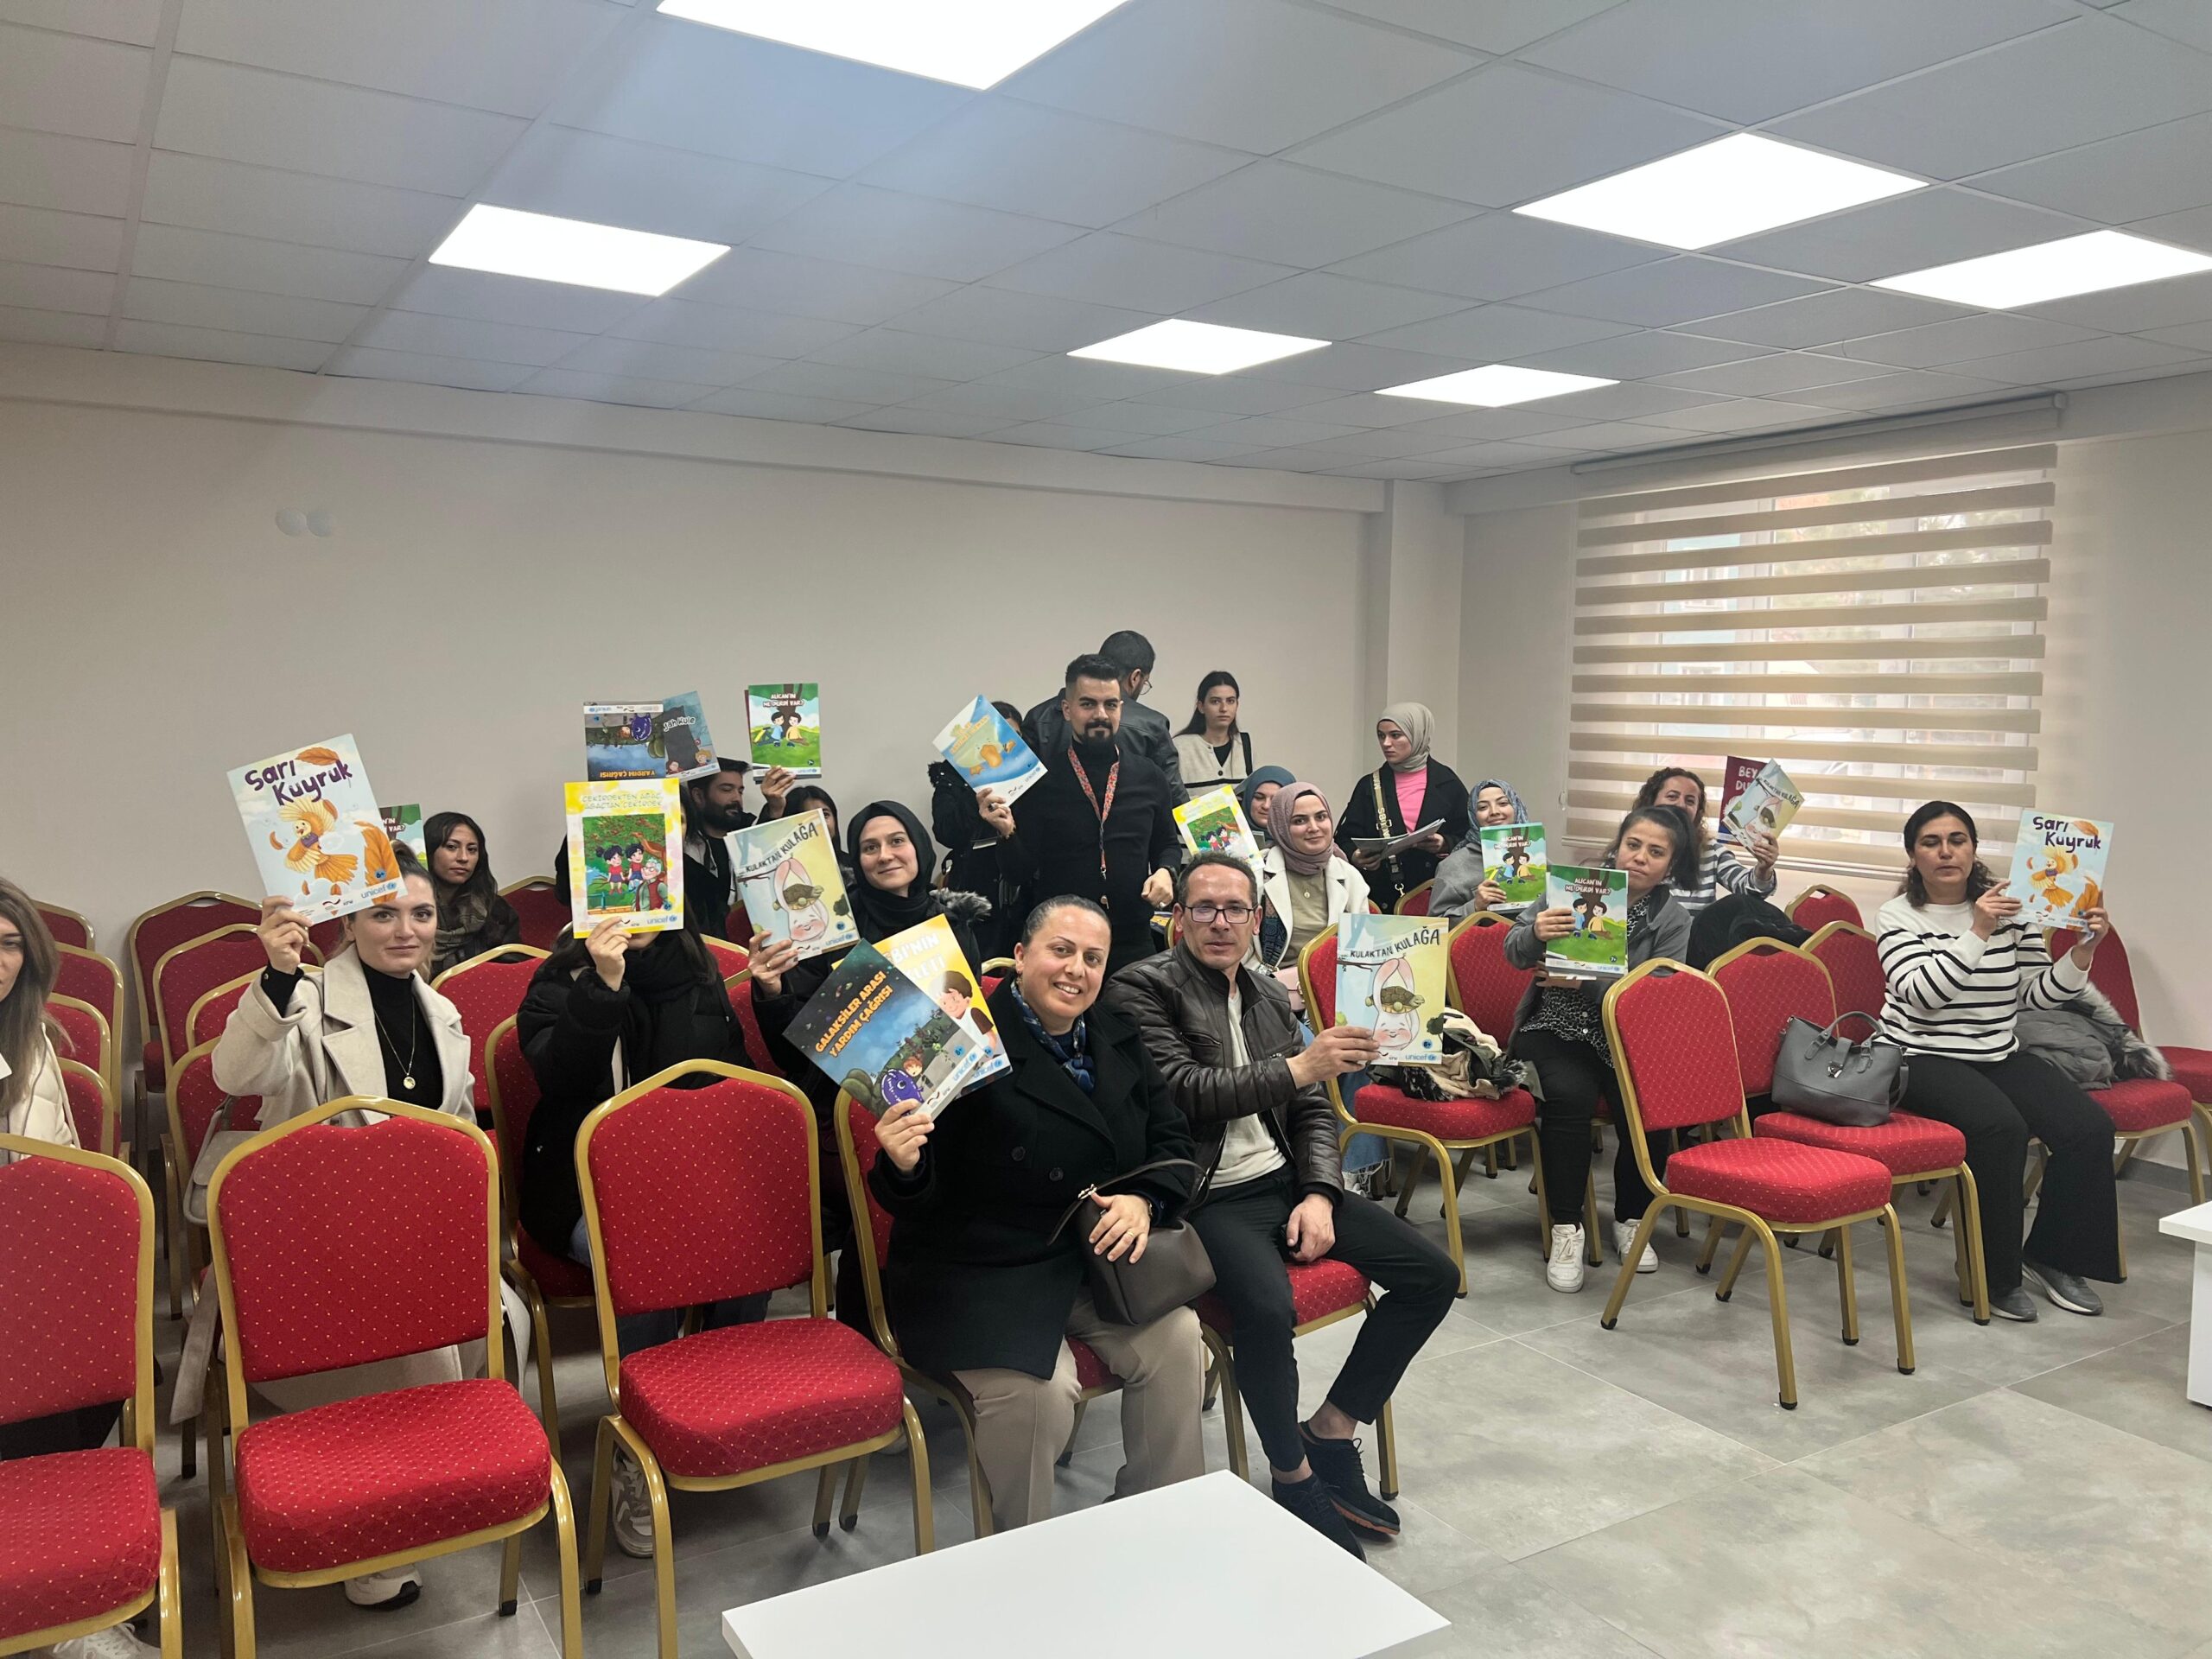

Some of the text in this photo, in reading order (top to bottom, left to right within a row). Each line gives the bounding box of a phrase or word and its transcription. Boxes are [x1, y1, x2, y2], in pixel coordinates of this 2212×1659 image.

[245, 760, 296, 791] Sarı
[272, 760, 353, 805] Kuyruk
[1738, 766, 1758, 779] BEY
[2033, 817, 2069, 832] Sarı
[746, 823, 818, 873] KULAKTAN KULAĞA
[2045, 831, 2101, 853] Kuyruk
[361, 885, 386, 899] unicef
[1351, 926, 1440, 958] KULAKTAN KULAĞA
[815, 970, 887, 1052] GALAKSİLER ARASI
[830, 985, 893, 1057] YARDIM ÇAĞRISI
